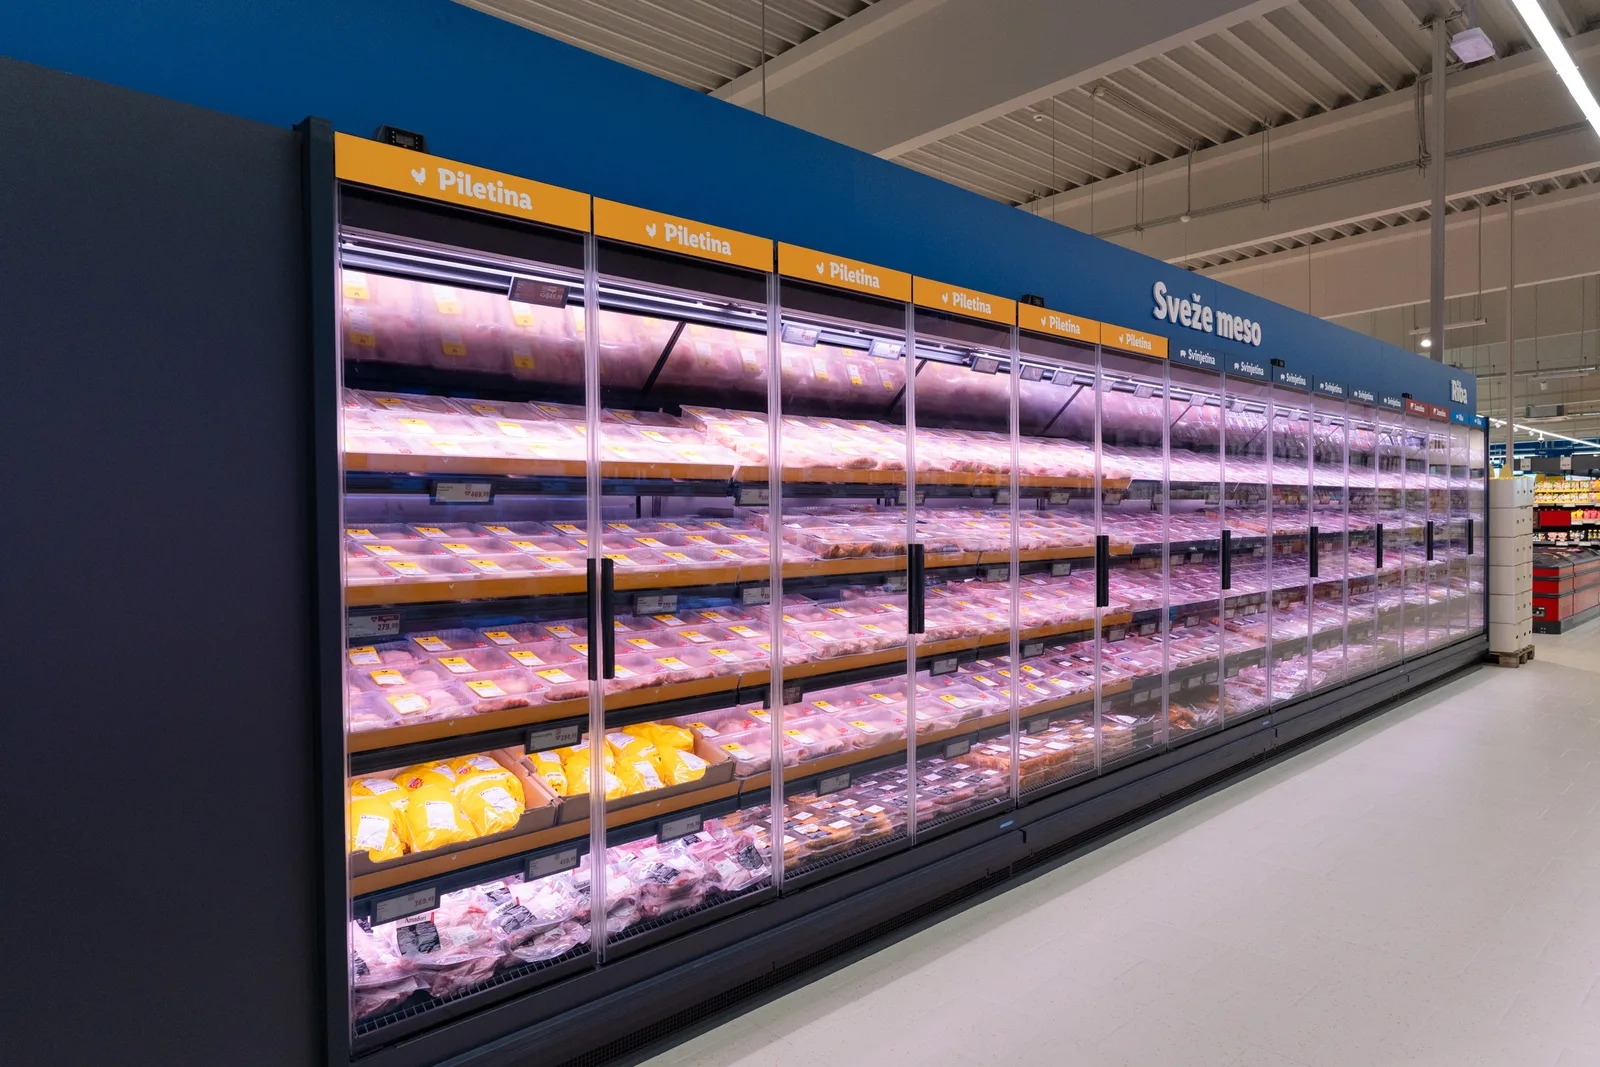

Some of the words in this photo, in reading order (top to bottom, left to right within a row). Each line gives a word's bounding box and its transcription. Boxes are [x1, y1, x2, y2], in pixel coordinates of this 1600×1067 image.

[437, 167, 533, 211] Piletina
[663, 221, 732, 257] Piletina
[829, 261, 880, 289] Piletina
[952, 291, 992, 315] Piletina
[1152, 281, 1213, 333] Sveže
[1216, 310, 1262, 347] meso
[1049, 315, 1081, 335] Piletina
[1125, 333, 1152, 351] Piletina
[1187, 348, 1216, 365] Svinjetina
[1240, 361, 1265, 376] Svinjetina
[1285, 372, 1307, 386] Svinjetina
[1450, 379, 1468, 405] Riba
[377, 622, 399, 631] 279.99
